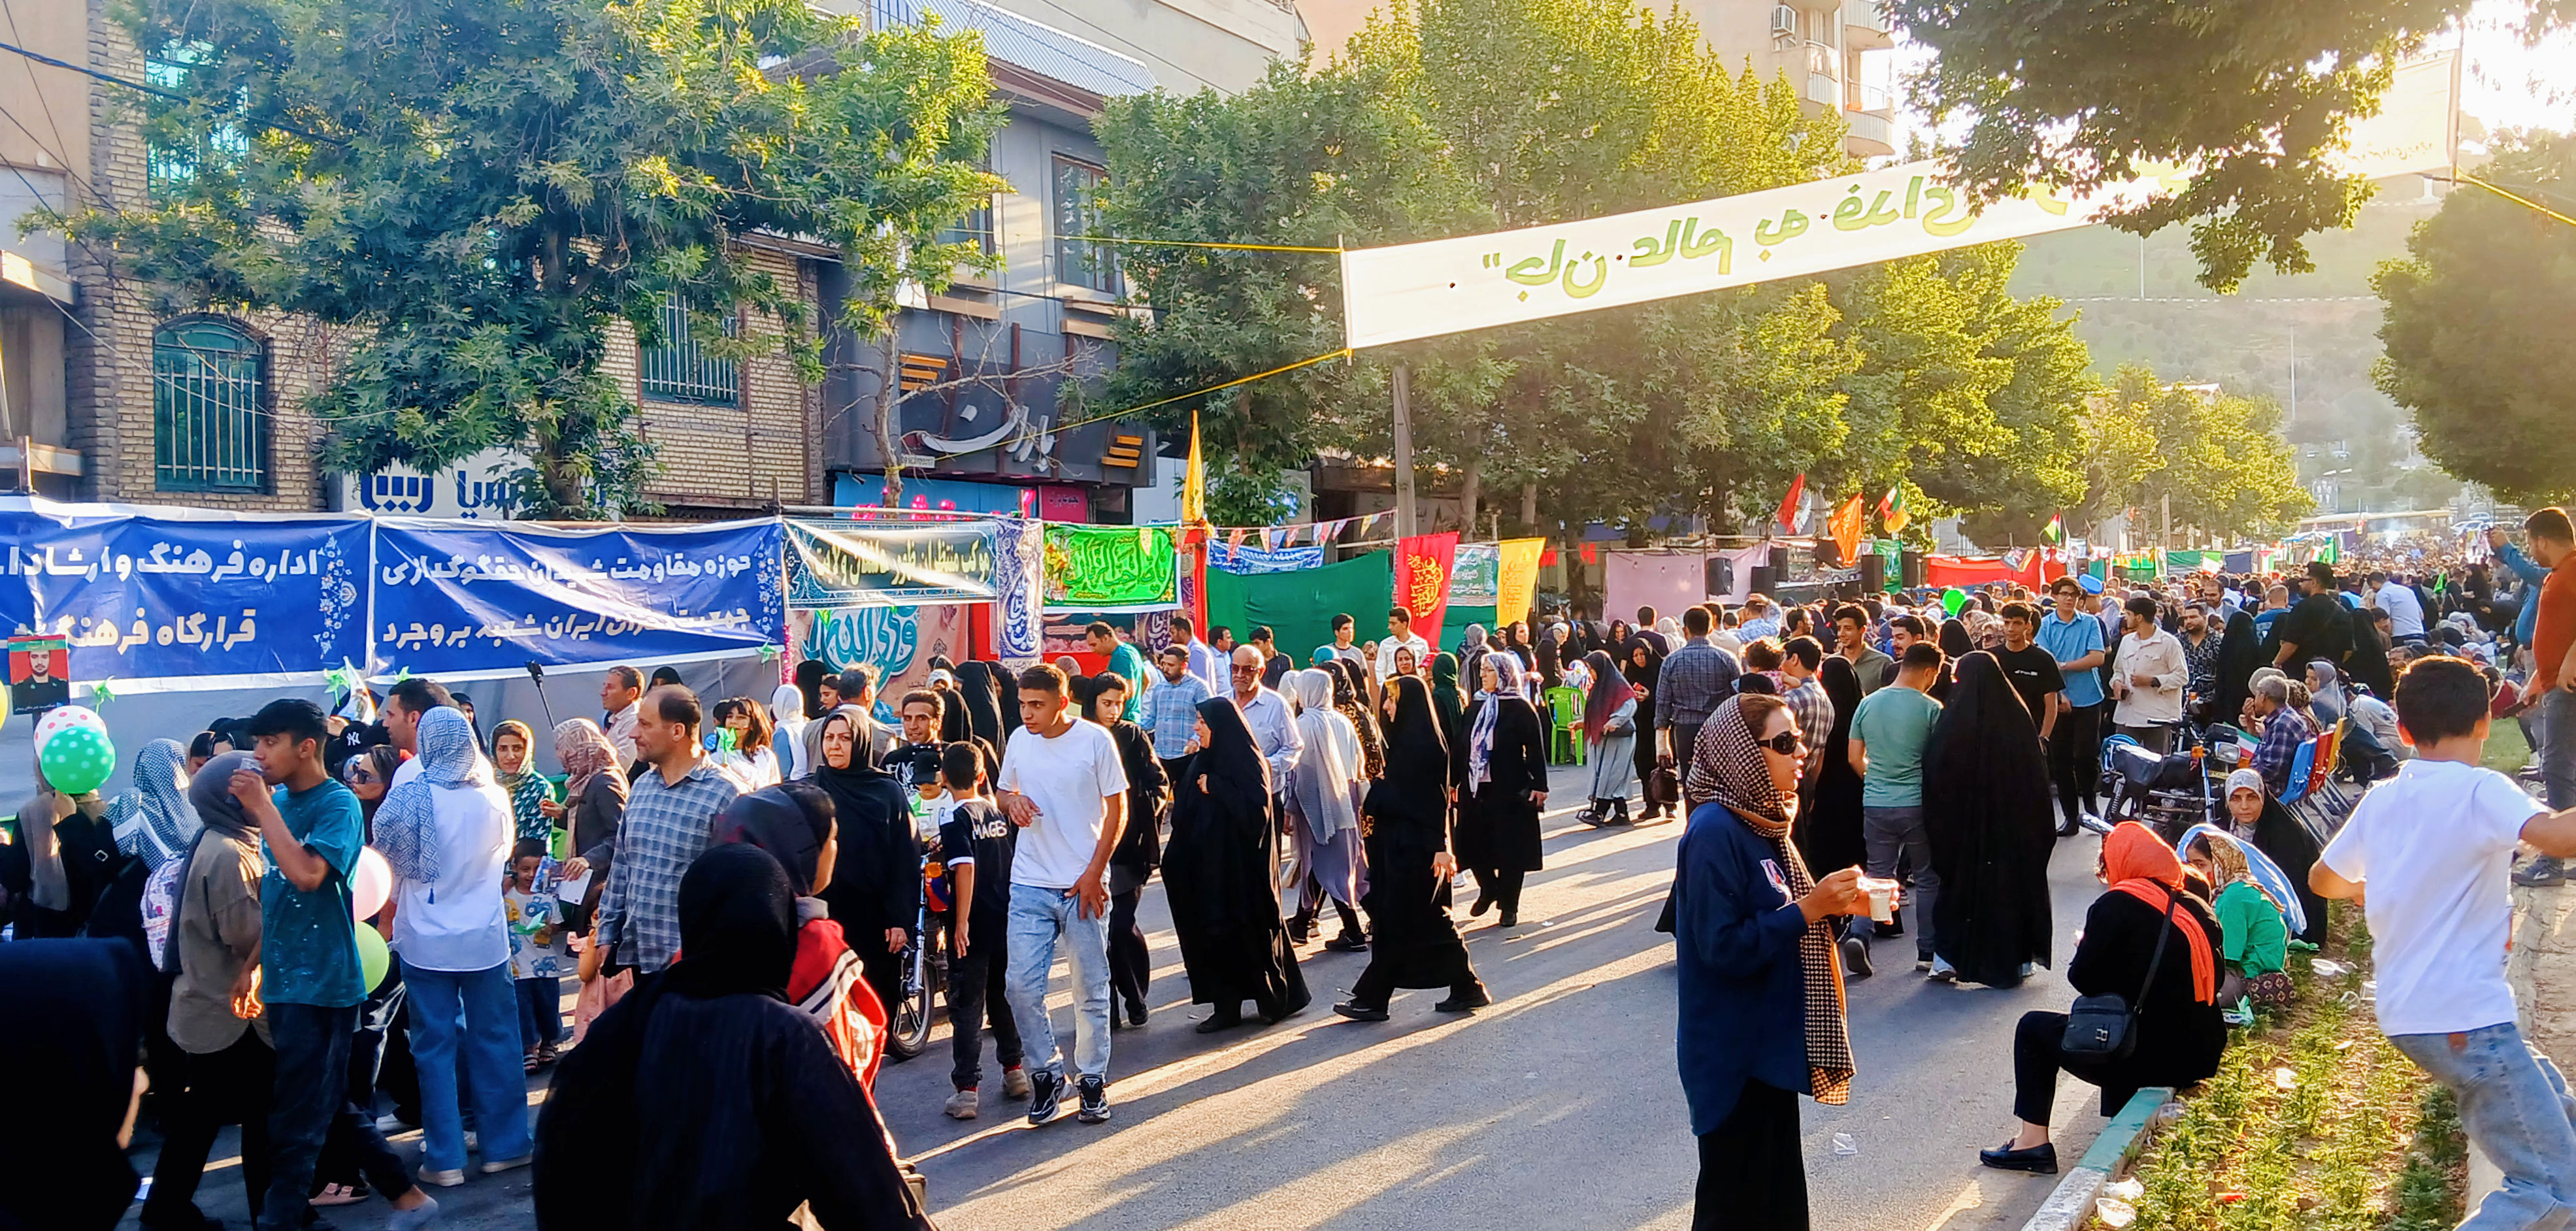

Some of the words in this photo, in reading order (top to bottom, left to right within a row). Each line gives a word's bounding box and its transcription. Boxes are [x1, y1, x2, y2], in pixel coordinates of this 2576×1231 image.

[136, 540, 246, 583] فرهنگ
[249, 549, 318, 583] اداره
[527, 558, 608, 589] شهیدان
[611, 553, 701, 583] مقاومت
[704, 553, 751, 579] حوزه
[156, 609, 256, 653] قرارگاه
[475, 614, 542, 647] شعبه
[545, 613, 606, 640] ایران
[673, 607, 751, 632] جمعیت
[382, 621, 472, 651] بروجرد
[346, 731, 361, 746] NY
